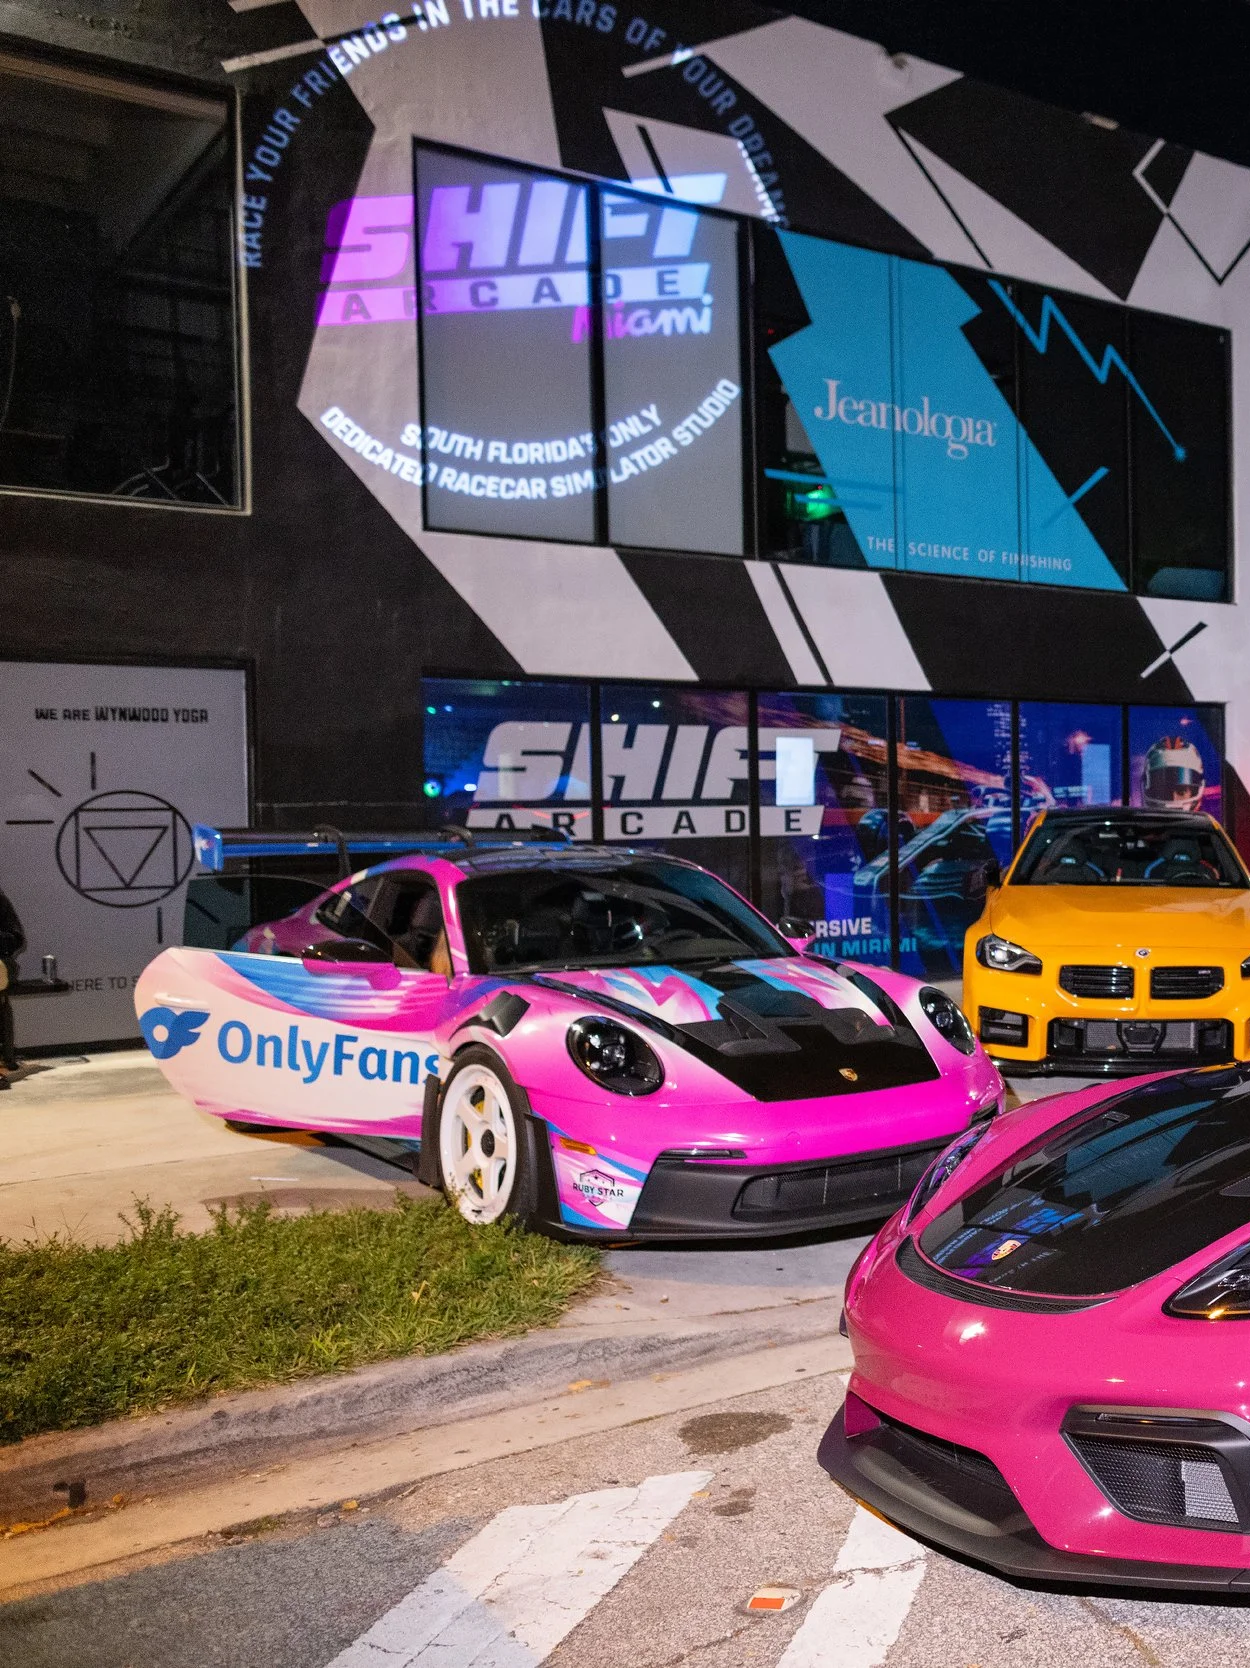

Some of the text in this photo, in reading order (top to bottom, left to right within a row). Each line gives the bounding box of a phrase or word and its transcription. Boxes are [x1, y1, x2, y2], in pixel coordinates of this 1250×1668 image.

[412, 0, 451, 32] IN
[532, 0, 617, 33] CARS
[625, 19, 667, 51] OF
[290, 11, 408, 110] FRIENDS
[671, 42, 737, 117] YOUR
[245, 107, 301, 182] YOUR
[240, 193, 268, 269] RACE
[320, 172, 728, 283] SHIFT
[341, 269, 681, 322] ARCADE
[813, 378, 997, 459] Jeanologia
[320, 378, 741, 500] DEDICATED RACECAR SIMLATOR STUDIO
[400, 423, 484, 462] SOUTH
[867, 535, 1073, 572] THE SCIENCE OF FINISHING
[35, 706, 208, 723] WE ARE WYNWOOD YOGA
[494, 808, 802, 837] ARCADE
[813, 917, 872, 938] RSIVE
[813, 941, 836, 957] IN
[108, 976, 127, 989] TO
[572, 1182, 595, 1195] RUBY
[597, 1187, 624, 1197] STAR
